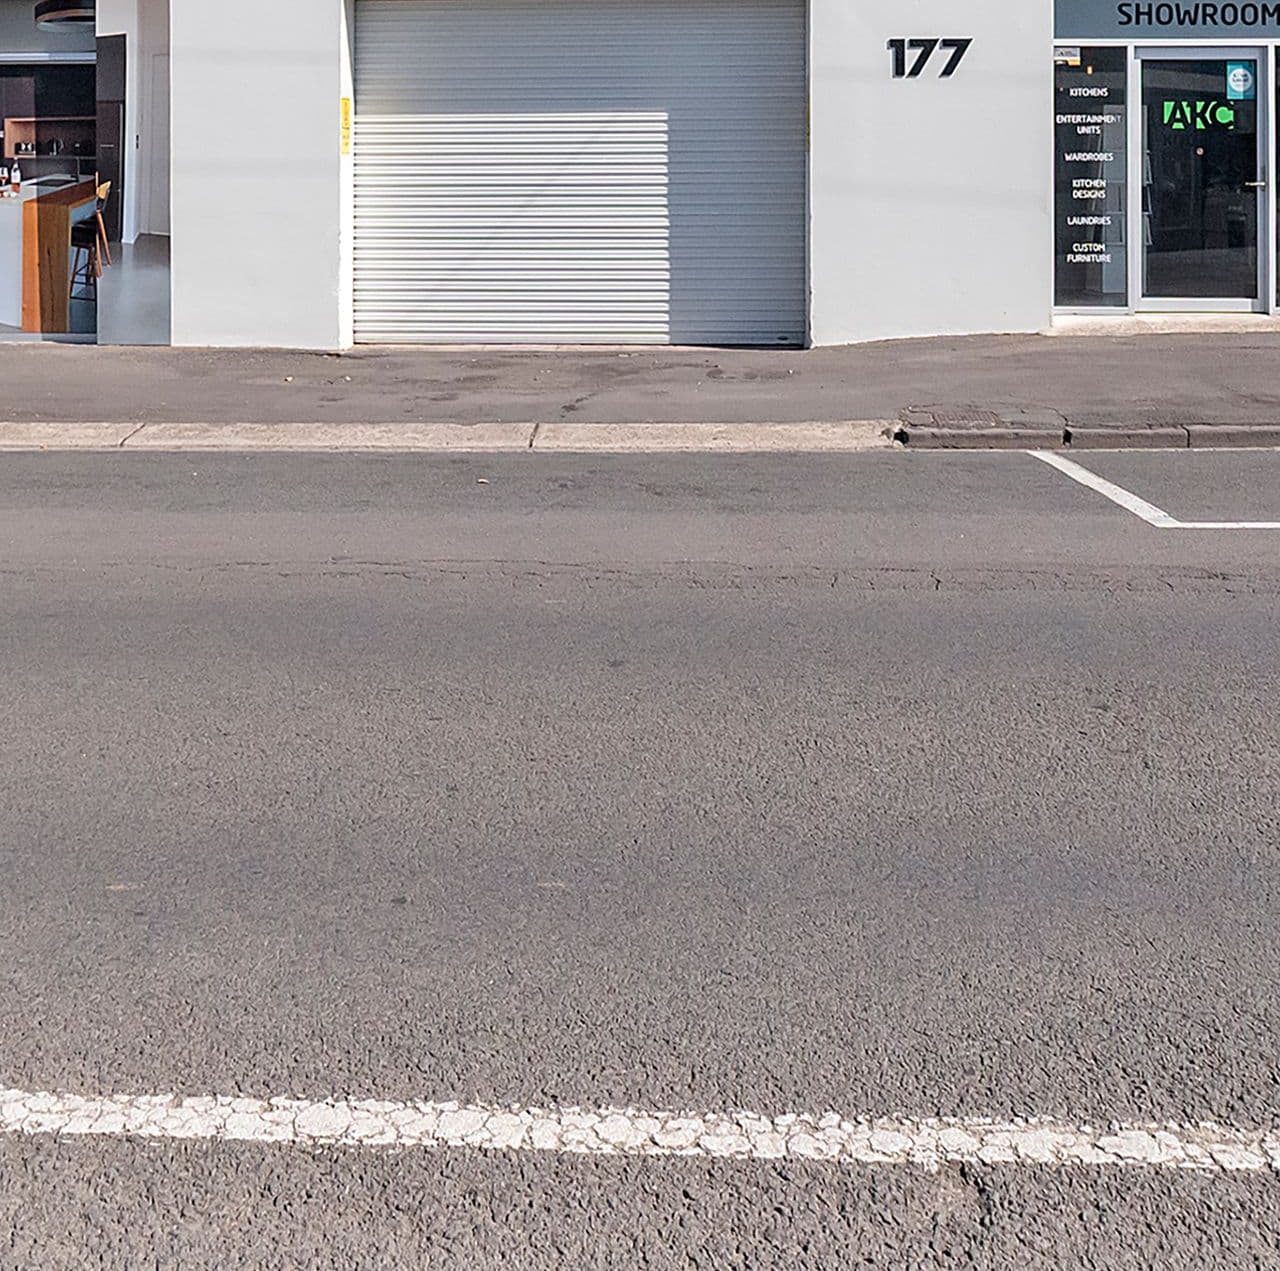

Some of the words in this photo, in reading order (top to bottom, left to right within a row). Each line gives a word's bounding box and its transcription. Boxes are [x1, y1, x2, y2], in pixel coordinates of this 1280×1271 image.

[886, 38, 973, 78] 177
[1069, 87, 1109, 97] KITCHENS
[1056, 114, 1122, 124] ENTERTAINMENT
[1163, 101, 1234, 129] AKC
[1076, 125, 1101, 135] UNITS
[1064, 152, 1114, 162] WARDROBES
[1072, 178, 1107, 188] KITCHEN
[1072, 189, 1106, 199] DESIGNS
[1067, 216, 1112, 225] LAUNDRIES
[1072, 242, 1106, 252] CUSTOM
[1066, 253, 1112, 263] FURNITURE
